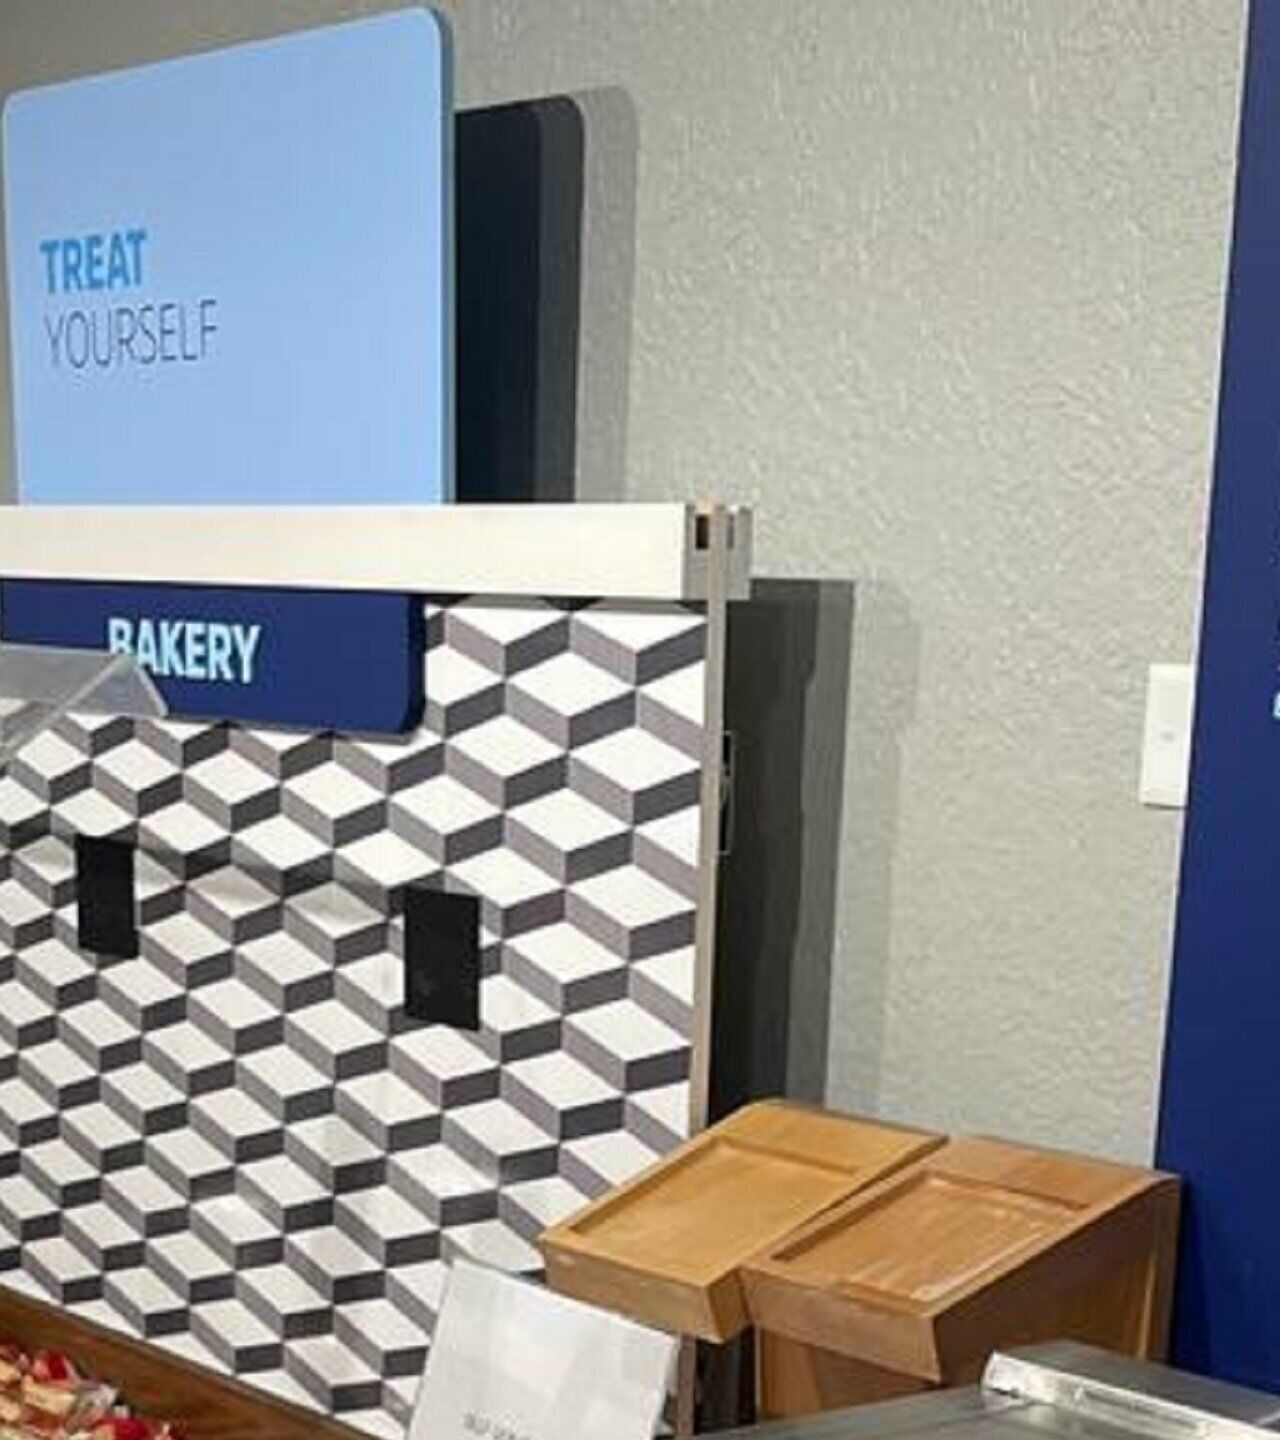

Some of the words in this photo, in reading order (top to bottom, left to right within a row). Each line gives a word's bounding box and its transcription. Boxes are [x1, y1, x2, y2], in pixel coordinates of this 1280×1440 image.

[39, 228, 147, 295] TREAT
[43, 299, 219, 369] YOURSELF
[108, 616, 262, 684] BAKERY
